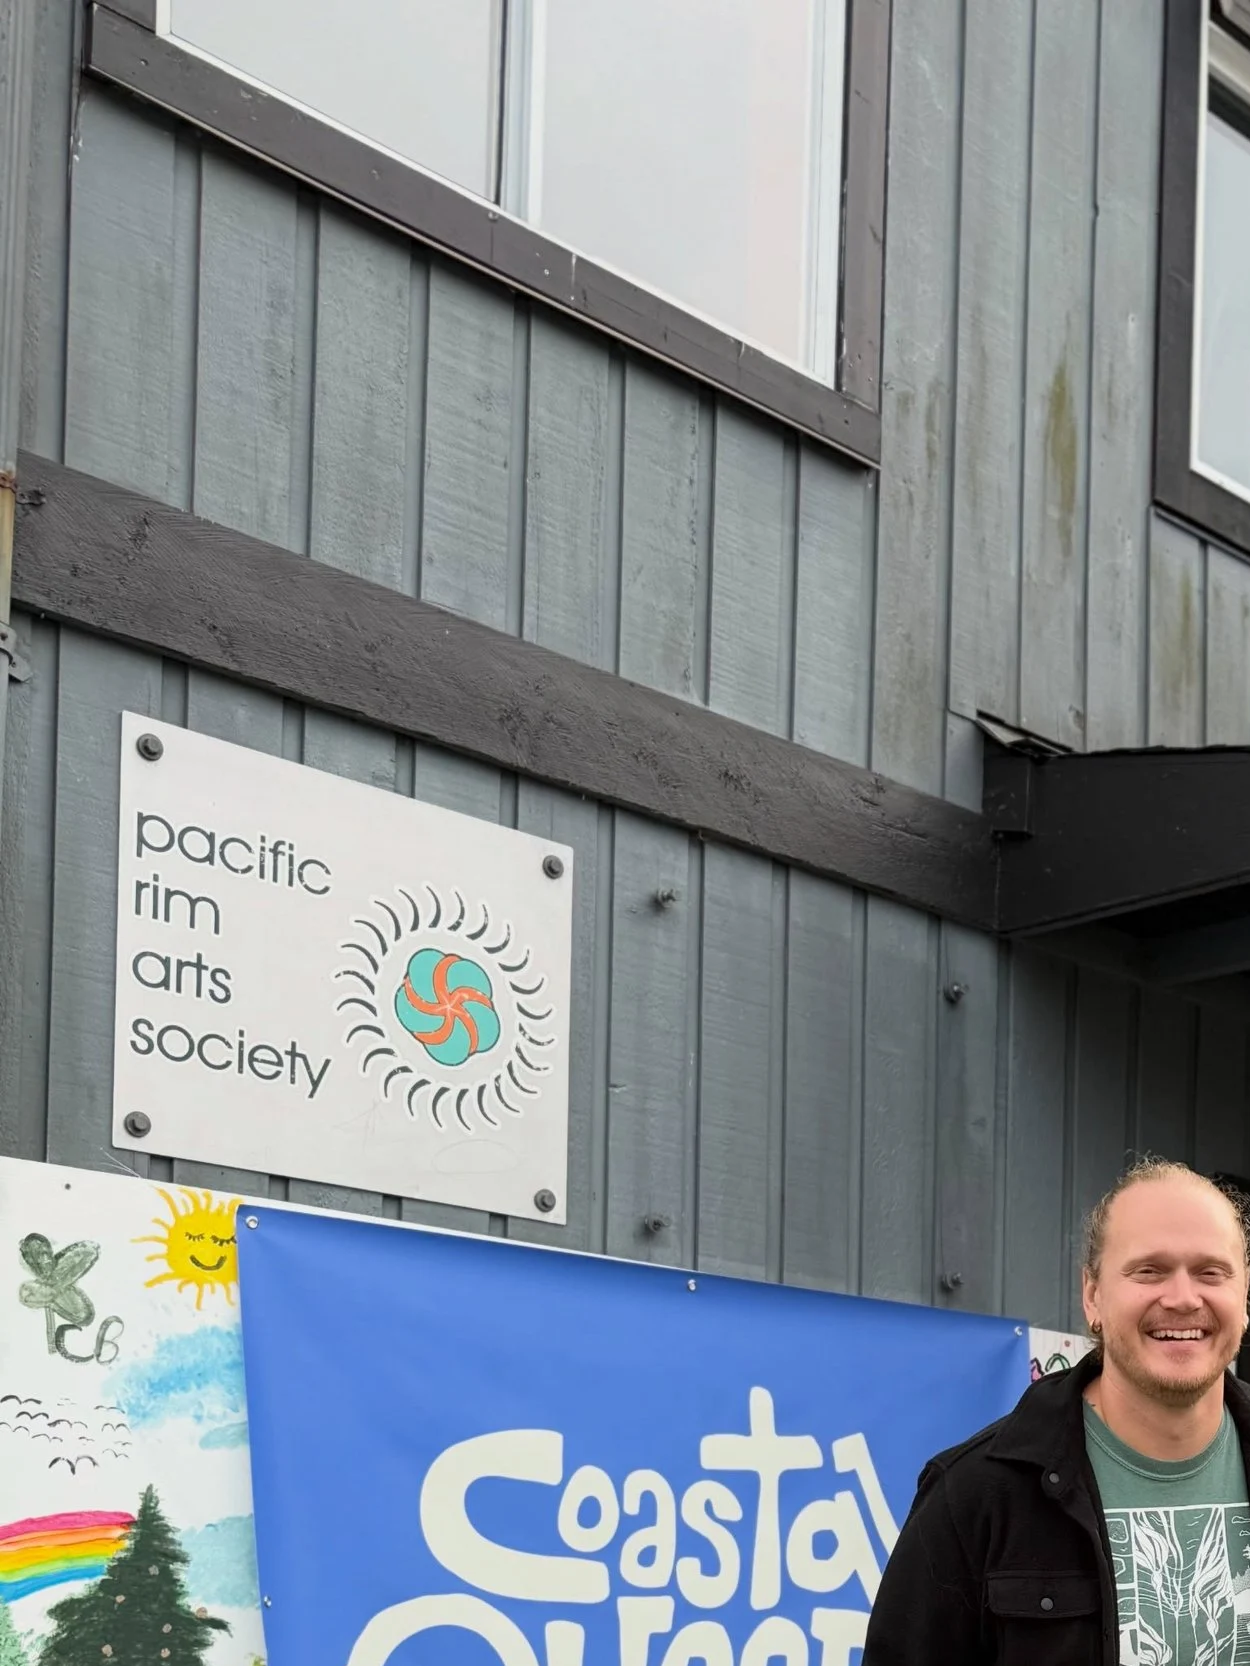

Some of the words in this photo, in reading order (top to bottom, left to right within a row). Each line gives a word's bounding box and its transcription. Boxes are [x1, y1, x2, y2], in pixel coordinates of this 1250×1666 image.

[136, 811, 332, 895] pacific
[134, 873, 221, 935] rim
[132, 950, 232, 1004] arts
[129, 1017, 332, 1099] society
